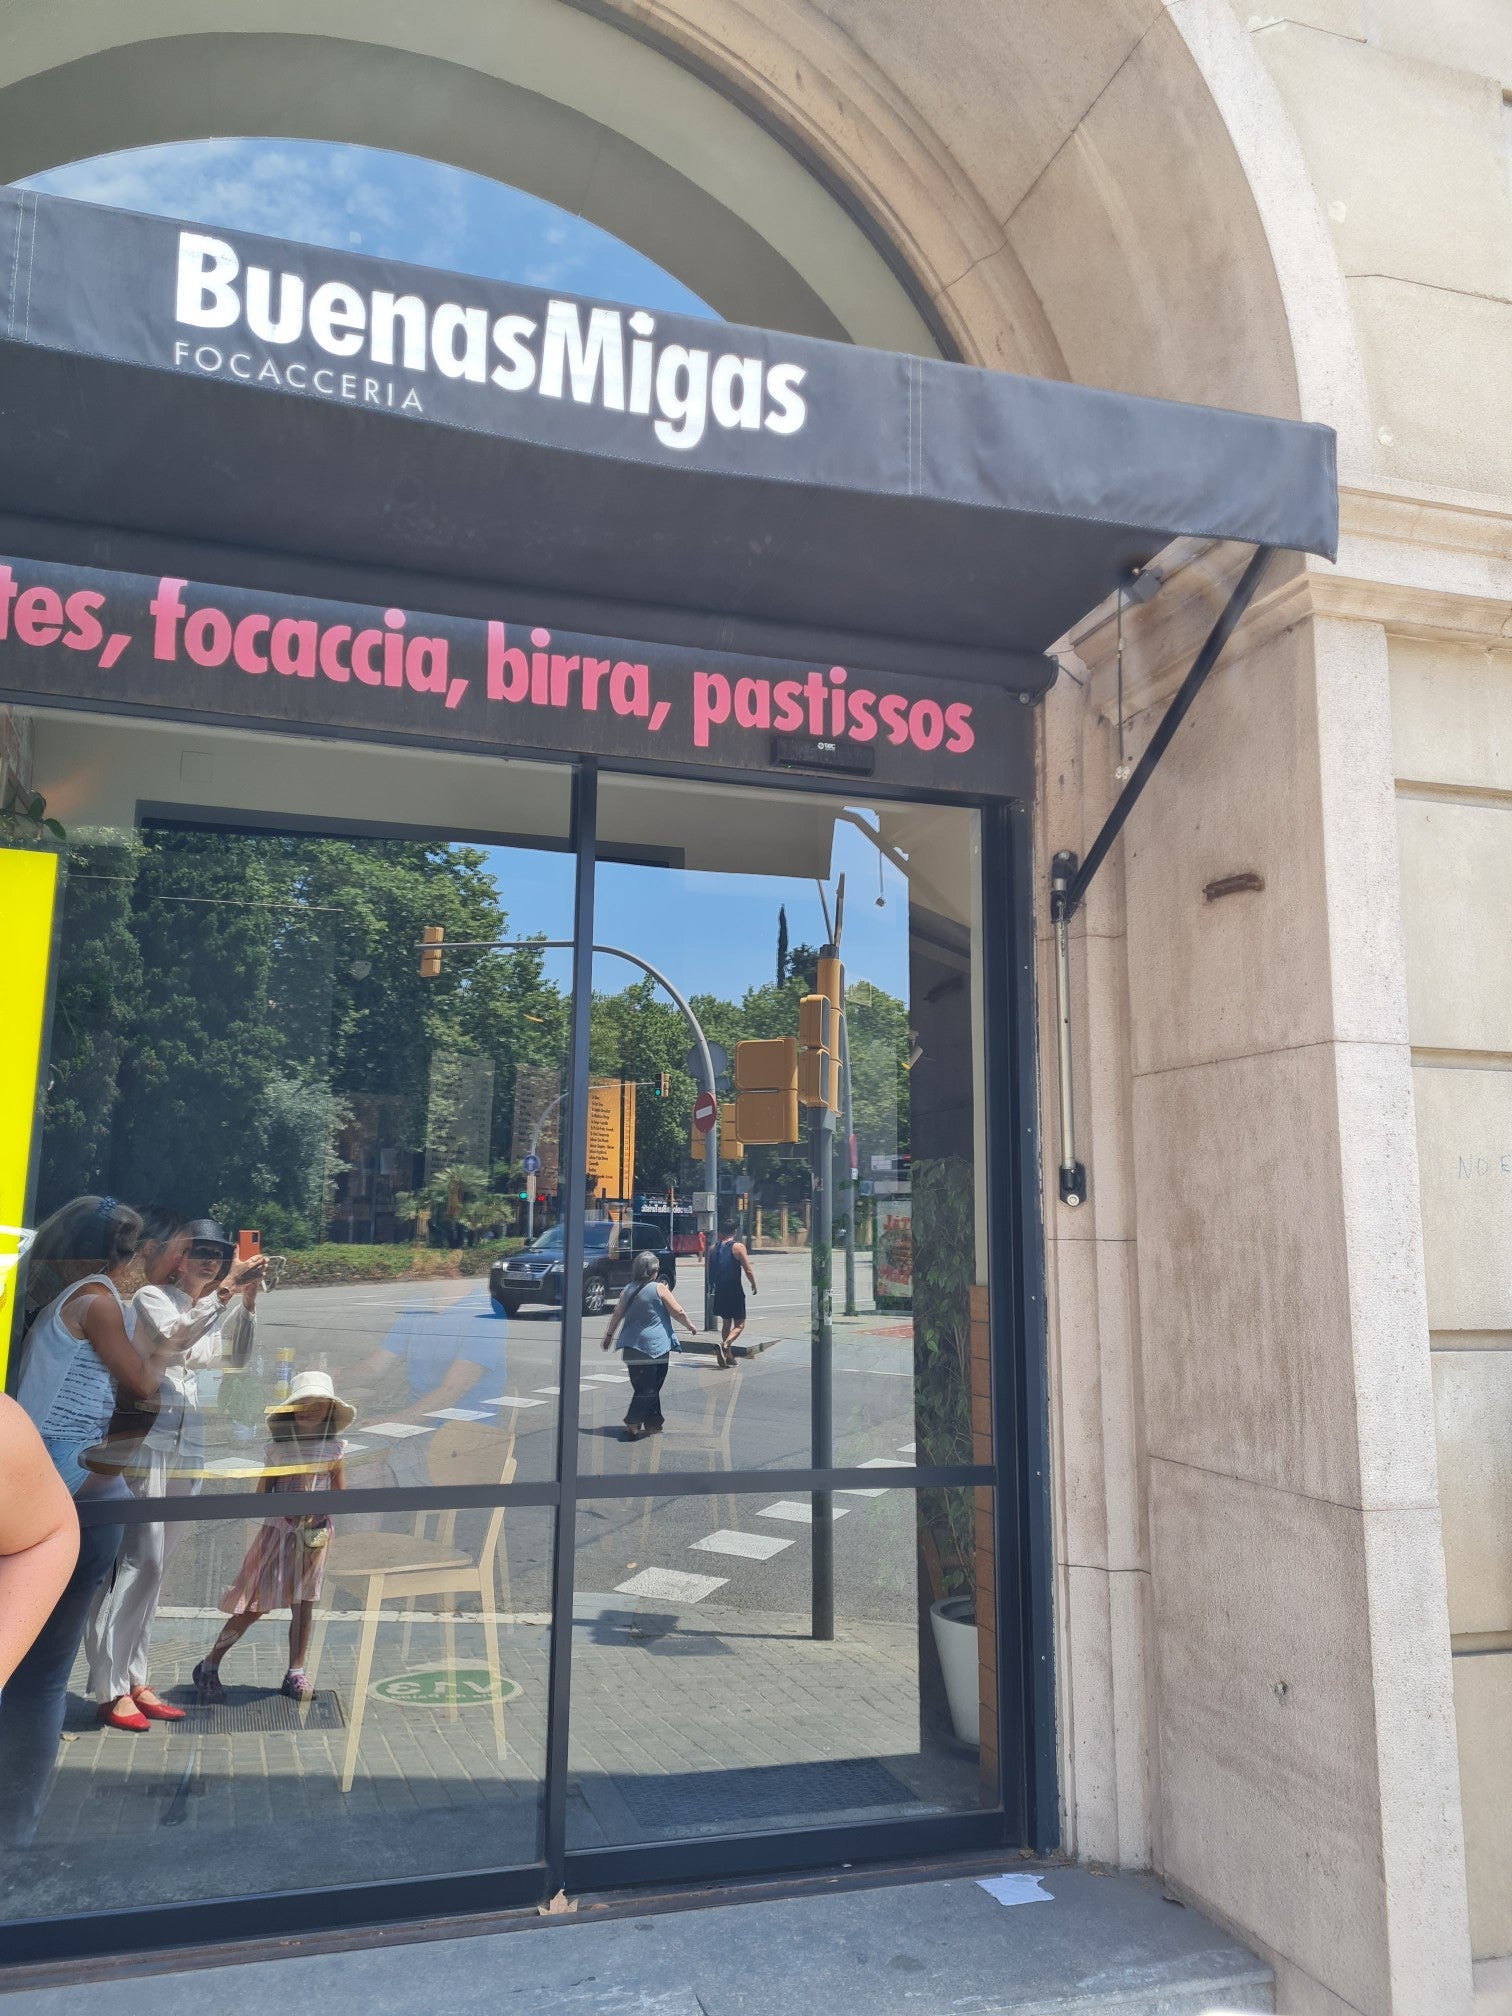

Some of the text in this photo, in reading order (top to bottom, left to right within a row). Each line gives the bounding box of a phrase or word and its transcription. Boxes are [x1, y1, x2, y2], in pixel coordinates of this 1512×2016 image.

[174, 341, 424, 412] FOCACCERIA
[176, 231, 807, 449] BuenasMigas
[150, 577, 469, 710] focaccia,
[487, 620, 672, 731] birra,
[693, 666, 975, 753] pastissos
